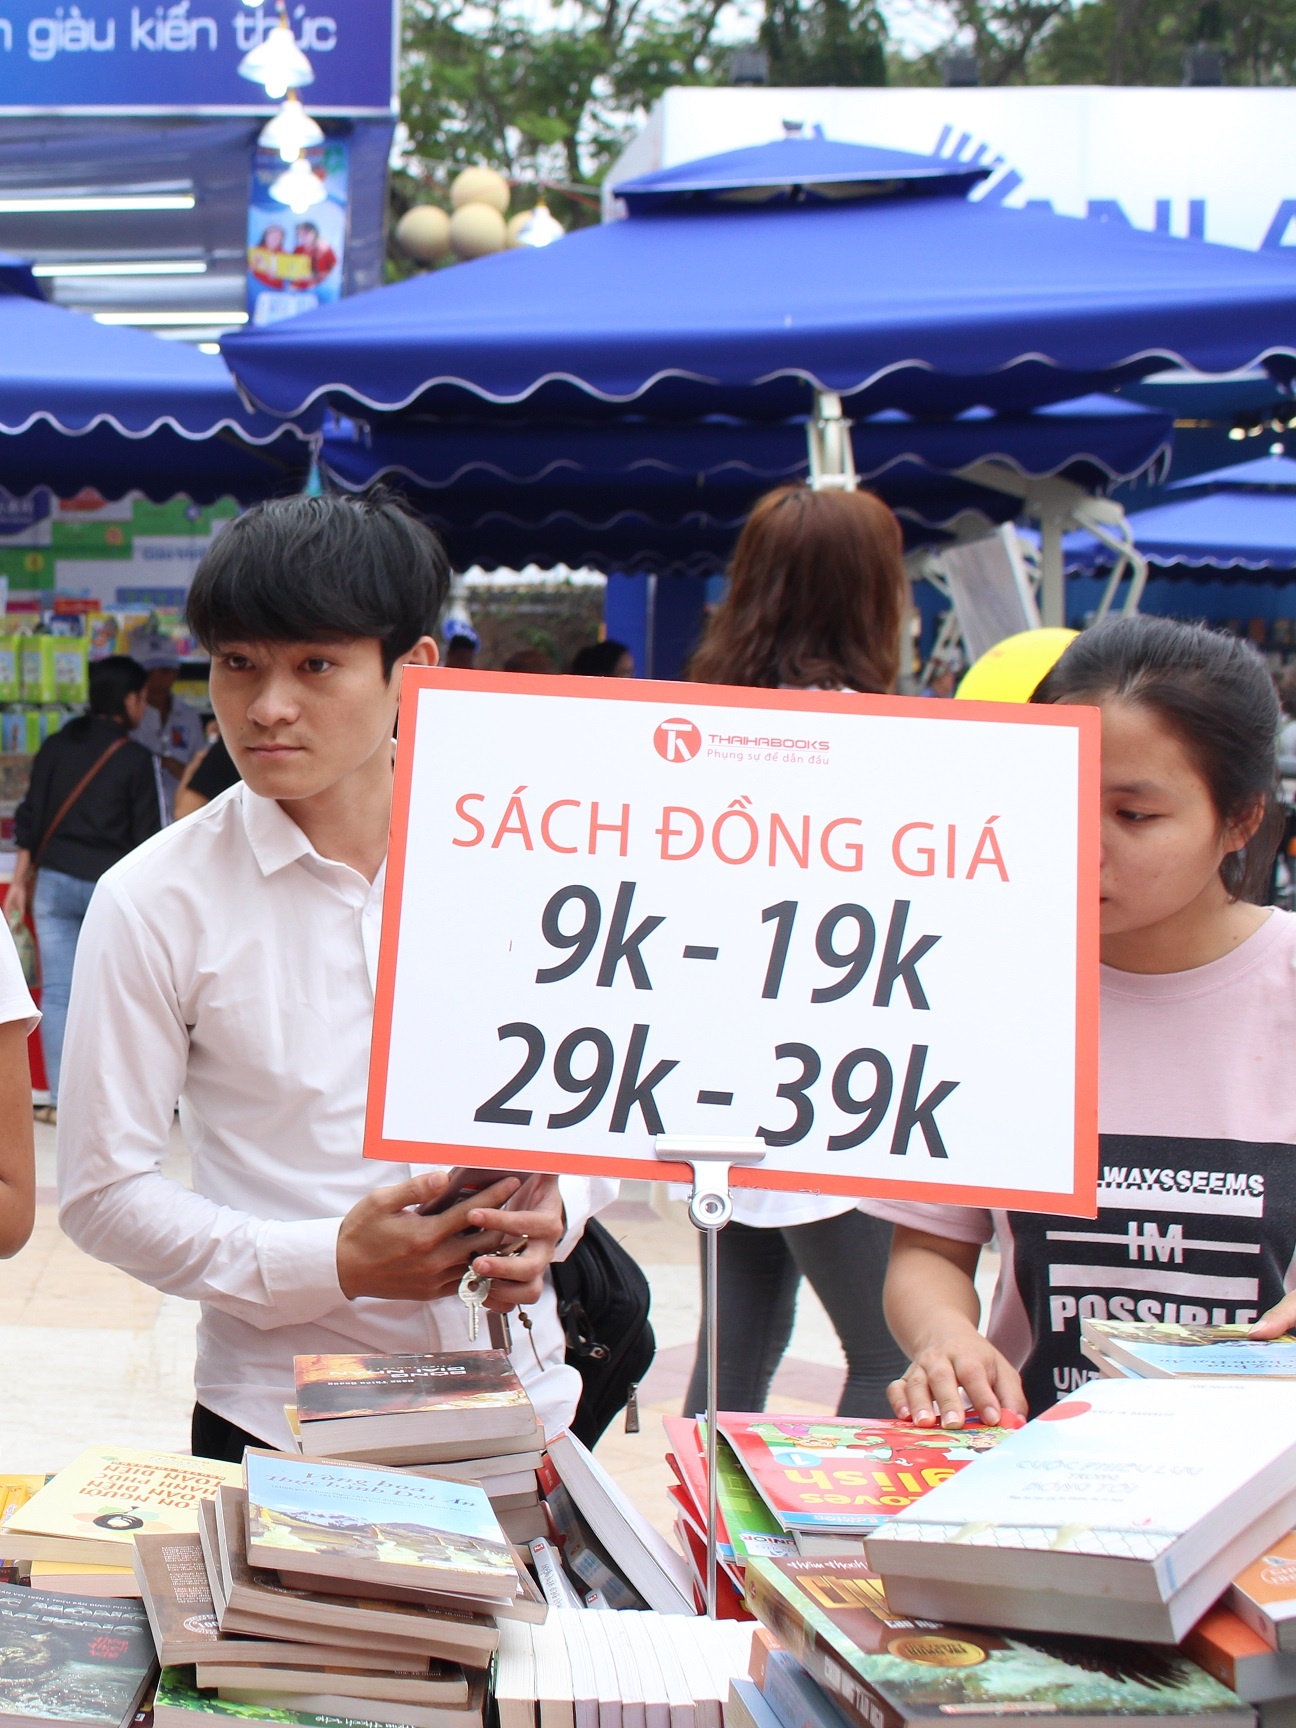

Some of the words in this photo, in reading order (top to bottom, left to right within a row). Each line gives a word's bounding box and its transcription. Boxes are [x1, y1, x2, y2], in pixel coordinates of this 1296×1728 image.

[27, 4, 115, 61] giàu
[130, 0, 218, 51] kiến
[707, 749, 744, 763] Phụng
[708, 734, 830, 750] THAIHABOOKS
[451, 784, 631, 858] SÁCH
[655, 795, 865, 873] ĐỒNG
[891, 814, 1010, 883] GIÁ
[535, 880, 666, 991] 9k
[760, 899, 943, 1011] 19k
[473, 1021, 681, 1136] 29k
[754, 1041, 961, 1160] 39k
[1127, 1221, 1184, 1264] IM
